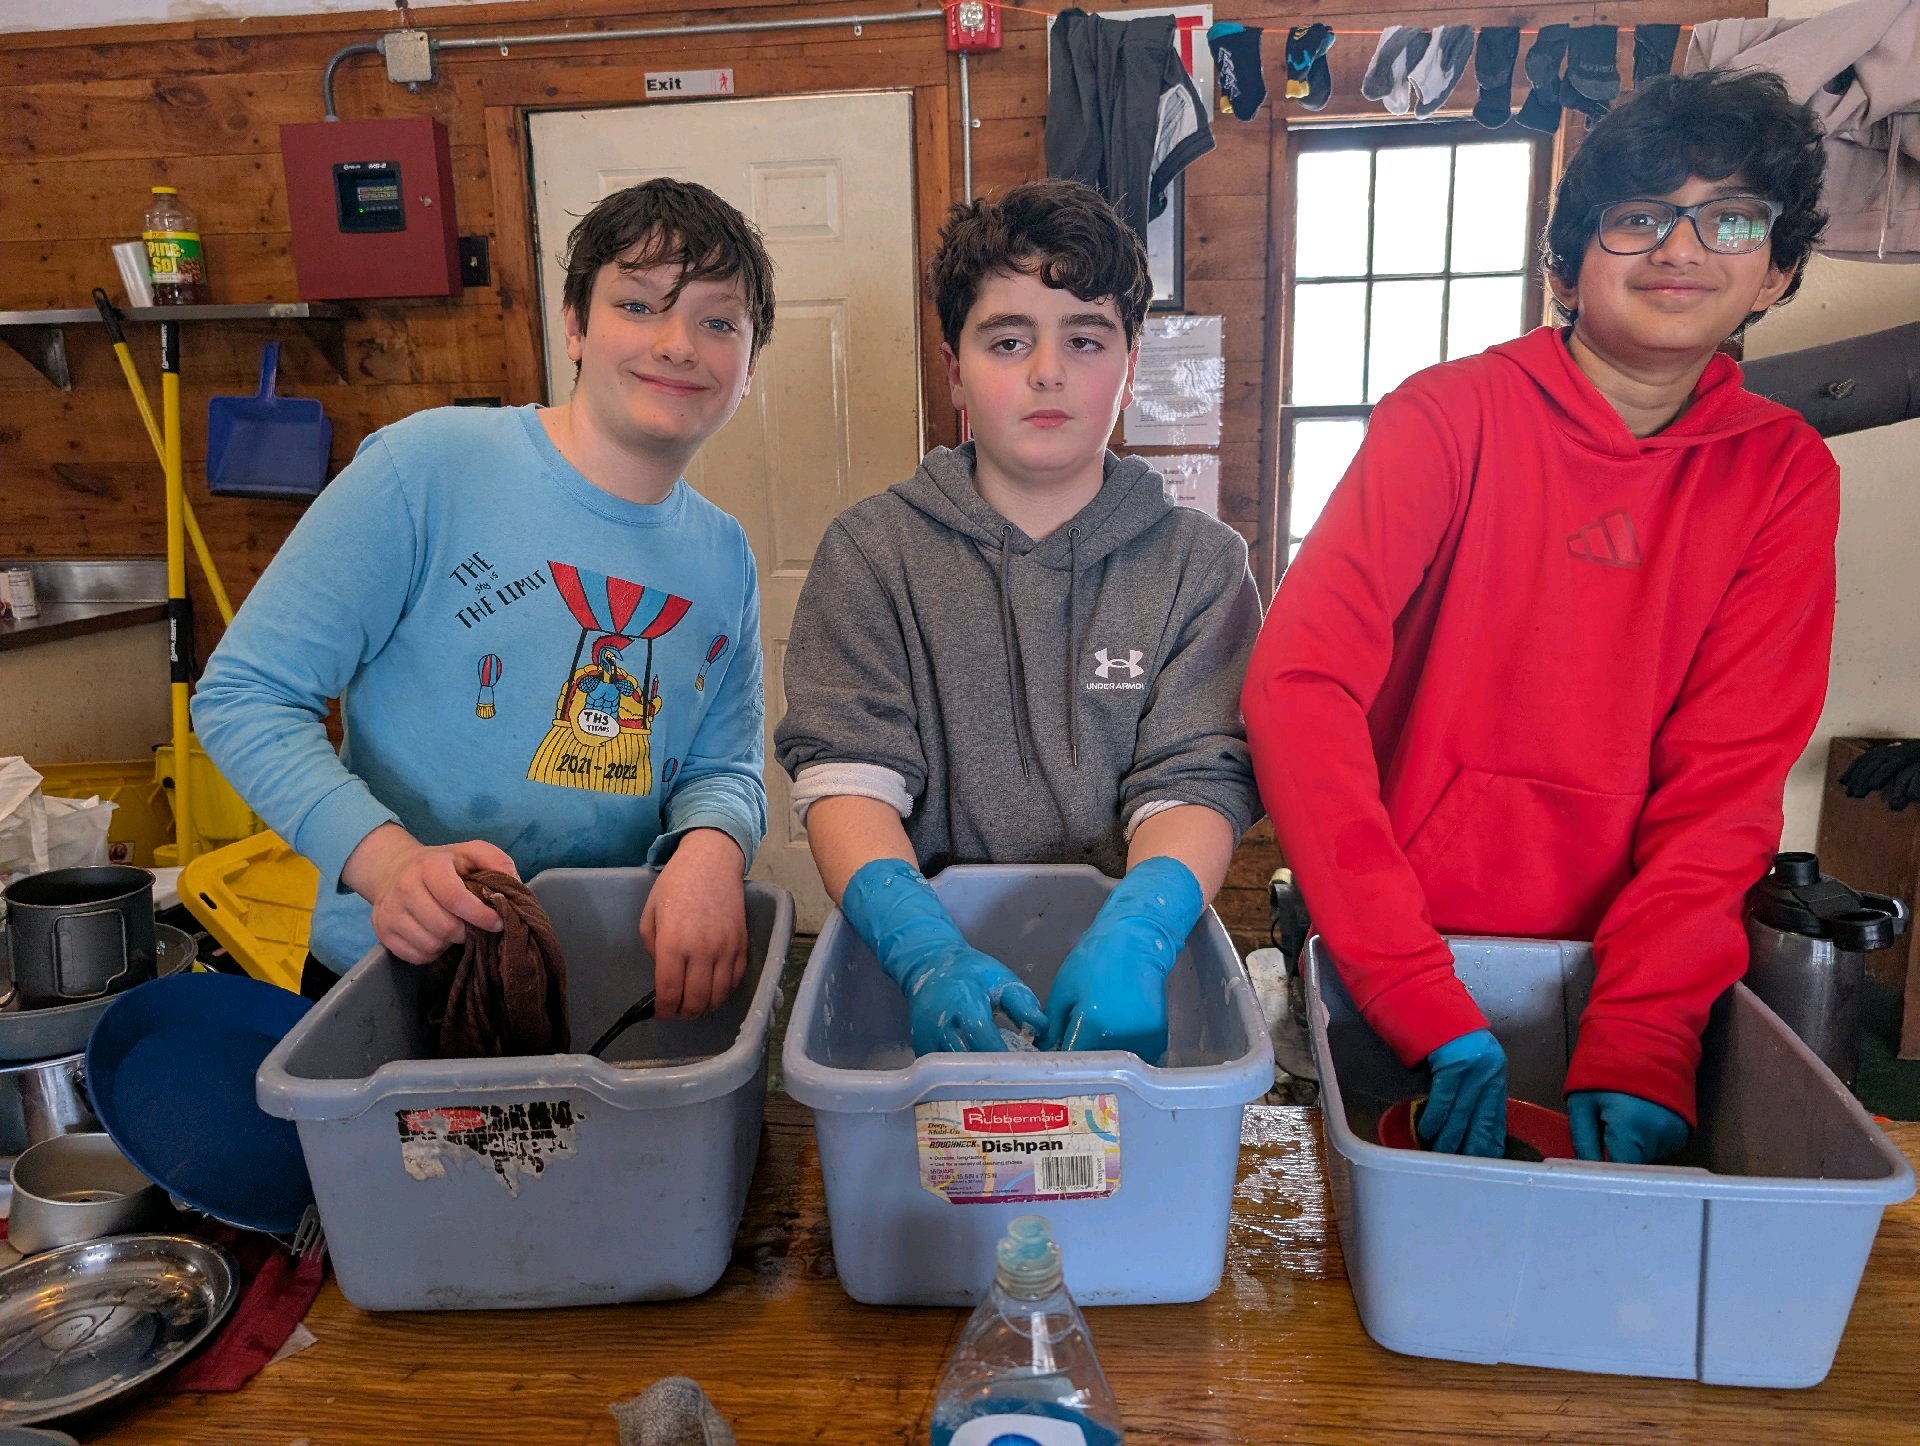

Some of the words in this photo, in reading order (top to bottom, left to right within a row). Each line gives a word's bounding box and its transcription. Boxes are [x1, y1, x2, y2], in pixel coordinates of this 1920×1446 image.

[646, 77, 682, 92] Exit
[152, 256, 178, 273] Sol
[449, 551, 495, 587] THE
[474, 581, 492, 595] sky
[488, 571, 499, 581] is
[454, 596, 497, 629] THE
[495, 569, 547, 606] LIMIT
[1086, 682, 1115, 690] UNDER
[583, 711, 609, 726] THS
[586, 724, 610, 733] TITANS
[968, 1109, 1065, 1125] Rubbermaid
[982, 1139, 1064, 1155] Dishpan
